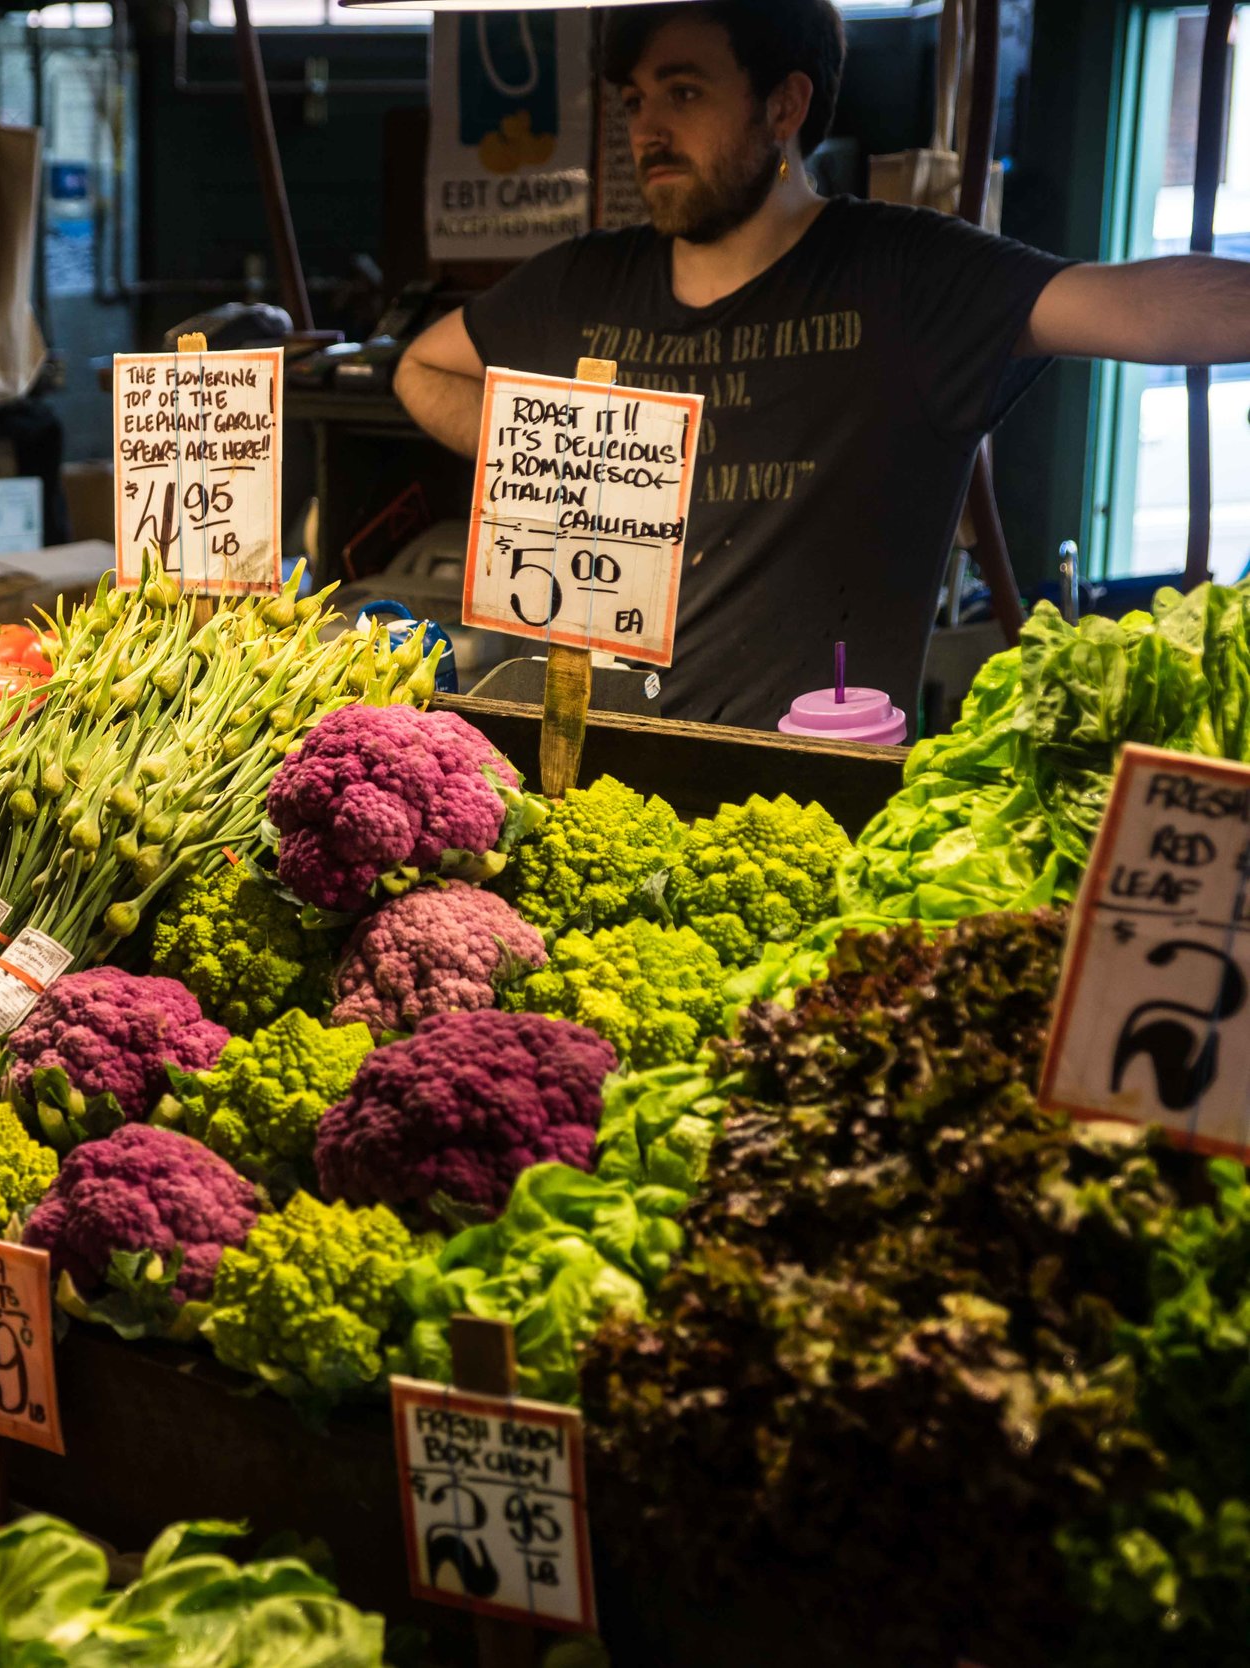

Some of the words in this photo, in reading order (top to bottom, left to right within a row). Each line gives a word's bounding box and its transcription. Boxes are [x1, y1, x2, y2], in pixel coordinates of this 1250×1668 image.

[443, 180, 490, 211] EBT
[495, 177, 573, 209] CARD
[732, 323, 768, 362] BE
[774, 311, 862, 356] HATED
[127, 366, 156, 384] THE
[166, 366, 256, 388] FLOWERING
[124, 390, 151, 408] TOP
[159, 390, 179, 407] OF
[189, 390, 227, 409] THE
[513, 397, 584, 429] ROAST
[125, 412, 212, 433] ELEPHANT
[120, 439, 180, 462] SPEARS
[185, 440, 217, 461] ARE
[499, 427, 542, 451] IT'S
[512, 452, 652, 488] ROMANESCO
[212, 532, 240, 556] LB
[615, 608, 643, 634] EA
[1146, 773, 1250, 823] FRESH
[1150, 824, 1216, 869] RED
[1109, 866, 1202, 904] LEAF
[415, 1407, 490, 1444] FRESH
[501, 1421, 564, 1459] BABY
[423, 1436, 479, 1469] BOK
[484, 1451, 550, 1483] CHOY
[529, 1561, 560, 1587] LB
